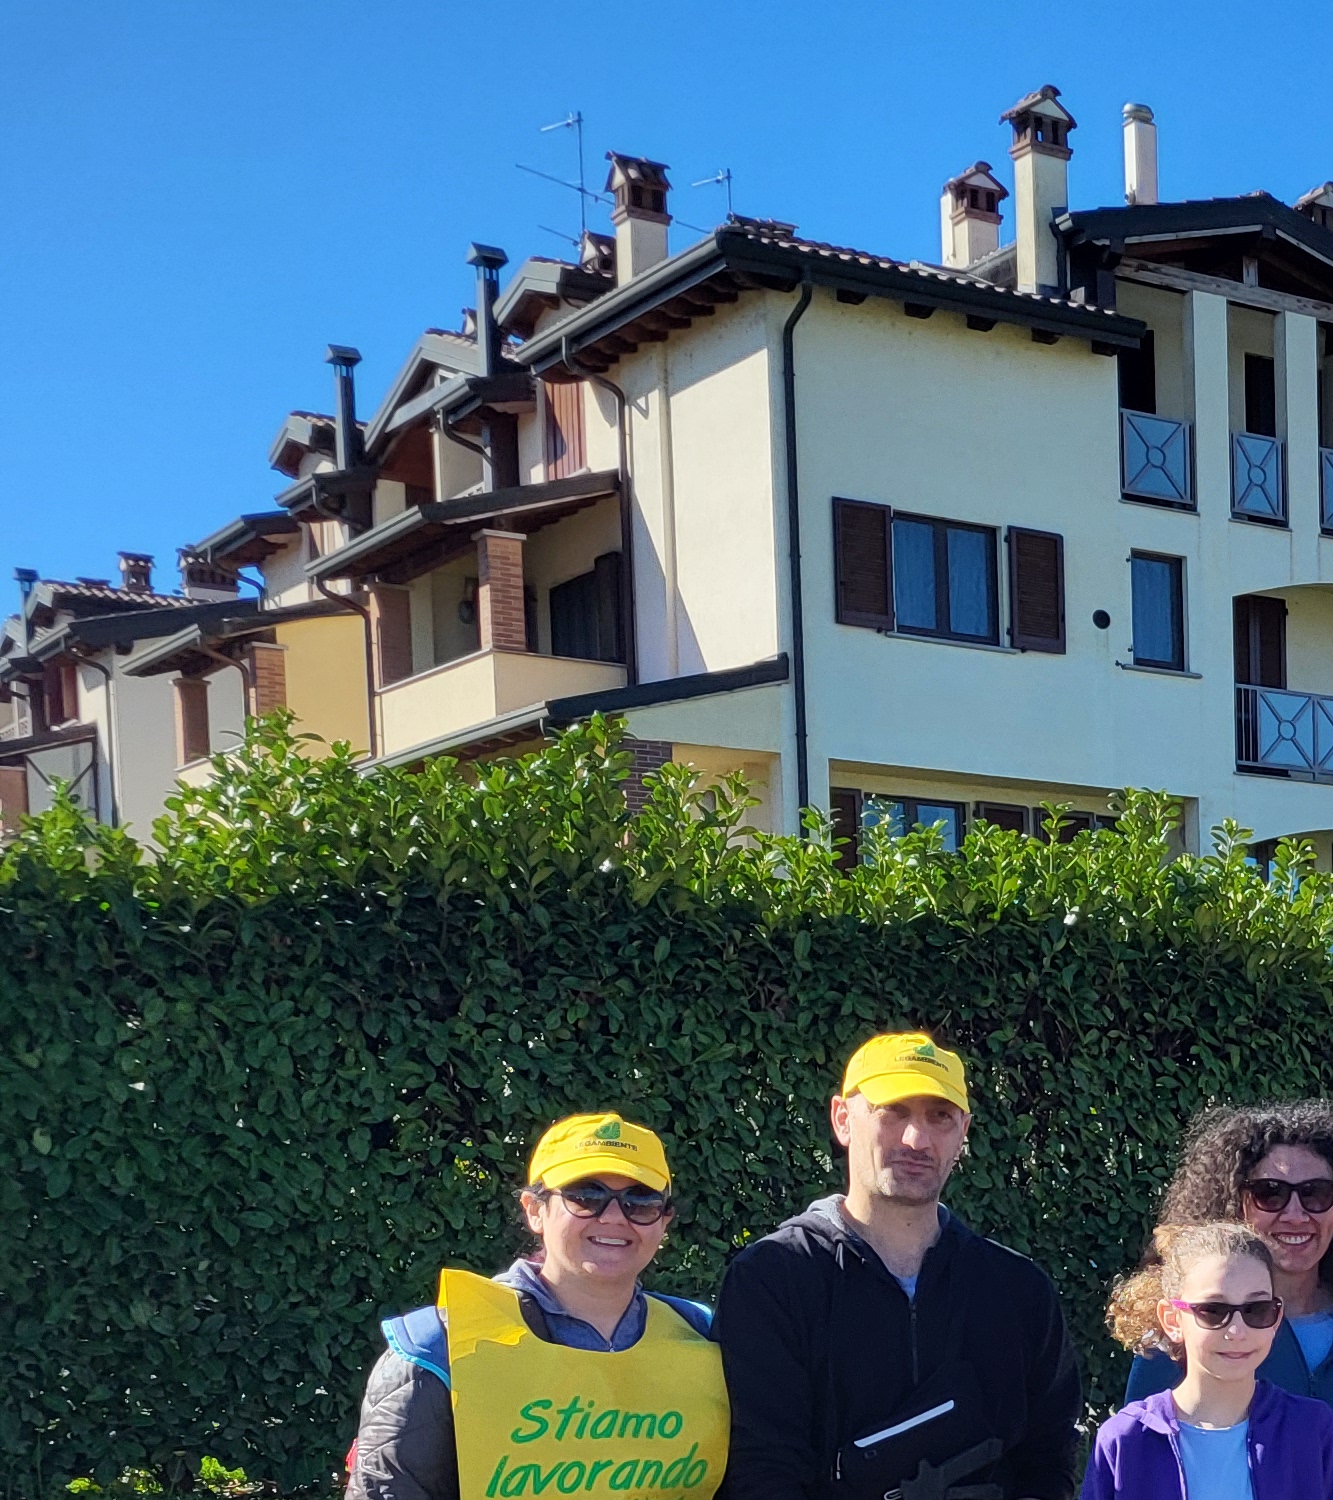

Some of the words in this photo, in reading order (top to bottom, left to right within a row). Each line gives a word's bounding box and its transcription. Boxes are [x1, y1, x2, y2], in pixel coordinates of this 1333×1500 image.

[574, 1140, 638, 1152] LEGAMBIENTE
[511, 1396, 683, 1444] Stiamo
[485, 1442, 709, 1499] lavorando
